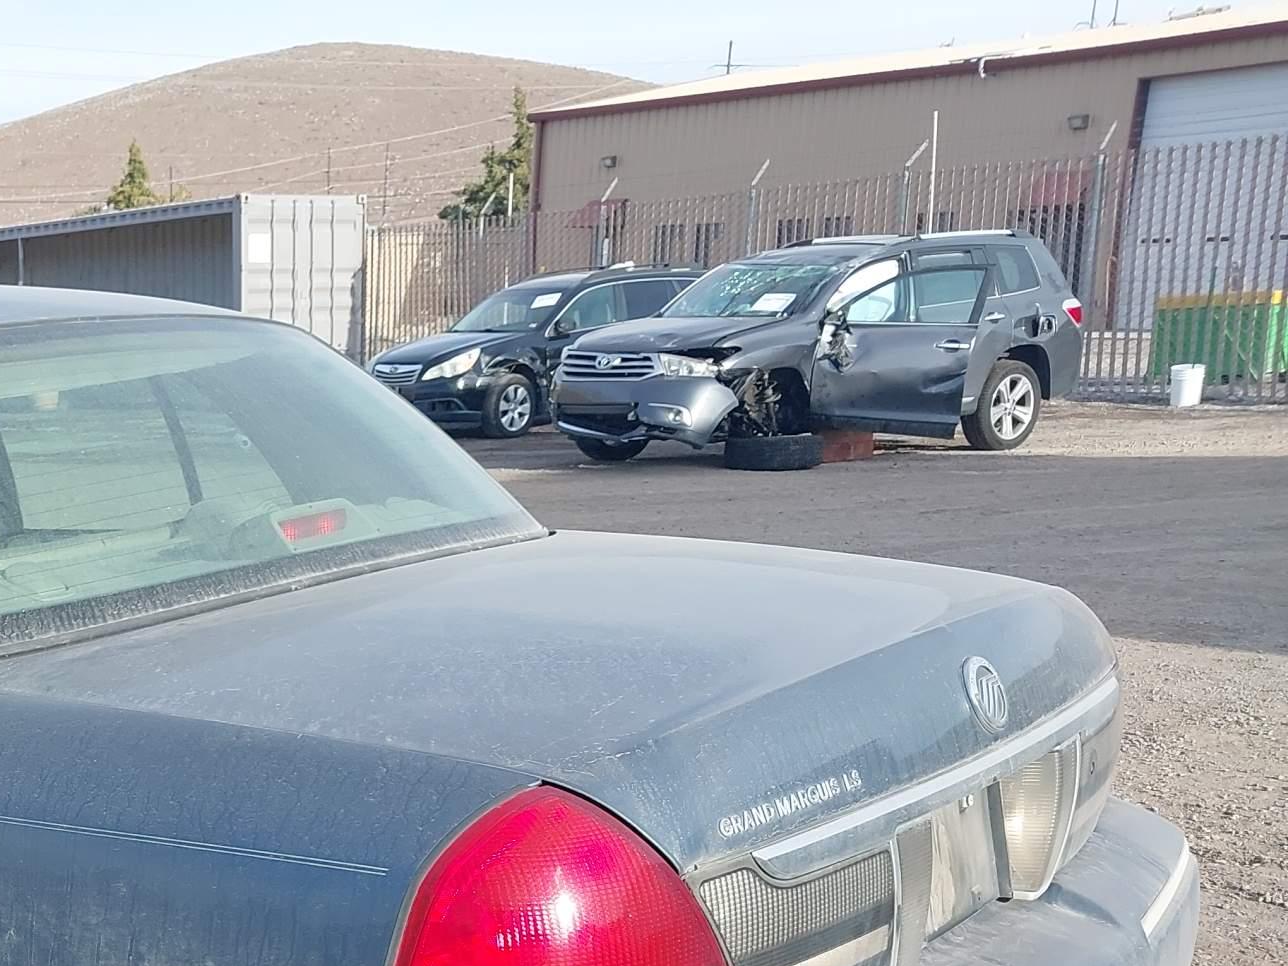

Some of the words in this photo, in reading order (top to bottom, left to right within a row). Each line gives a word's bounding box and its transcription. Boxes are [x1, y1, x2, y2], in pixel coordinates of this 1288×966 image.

[719, 803, 775, 838] GRAND
[775, 777, 841, 817] MARQUIS
[842, 769, 862, 792] LS
